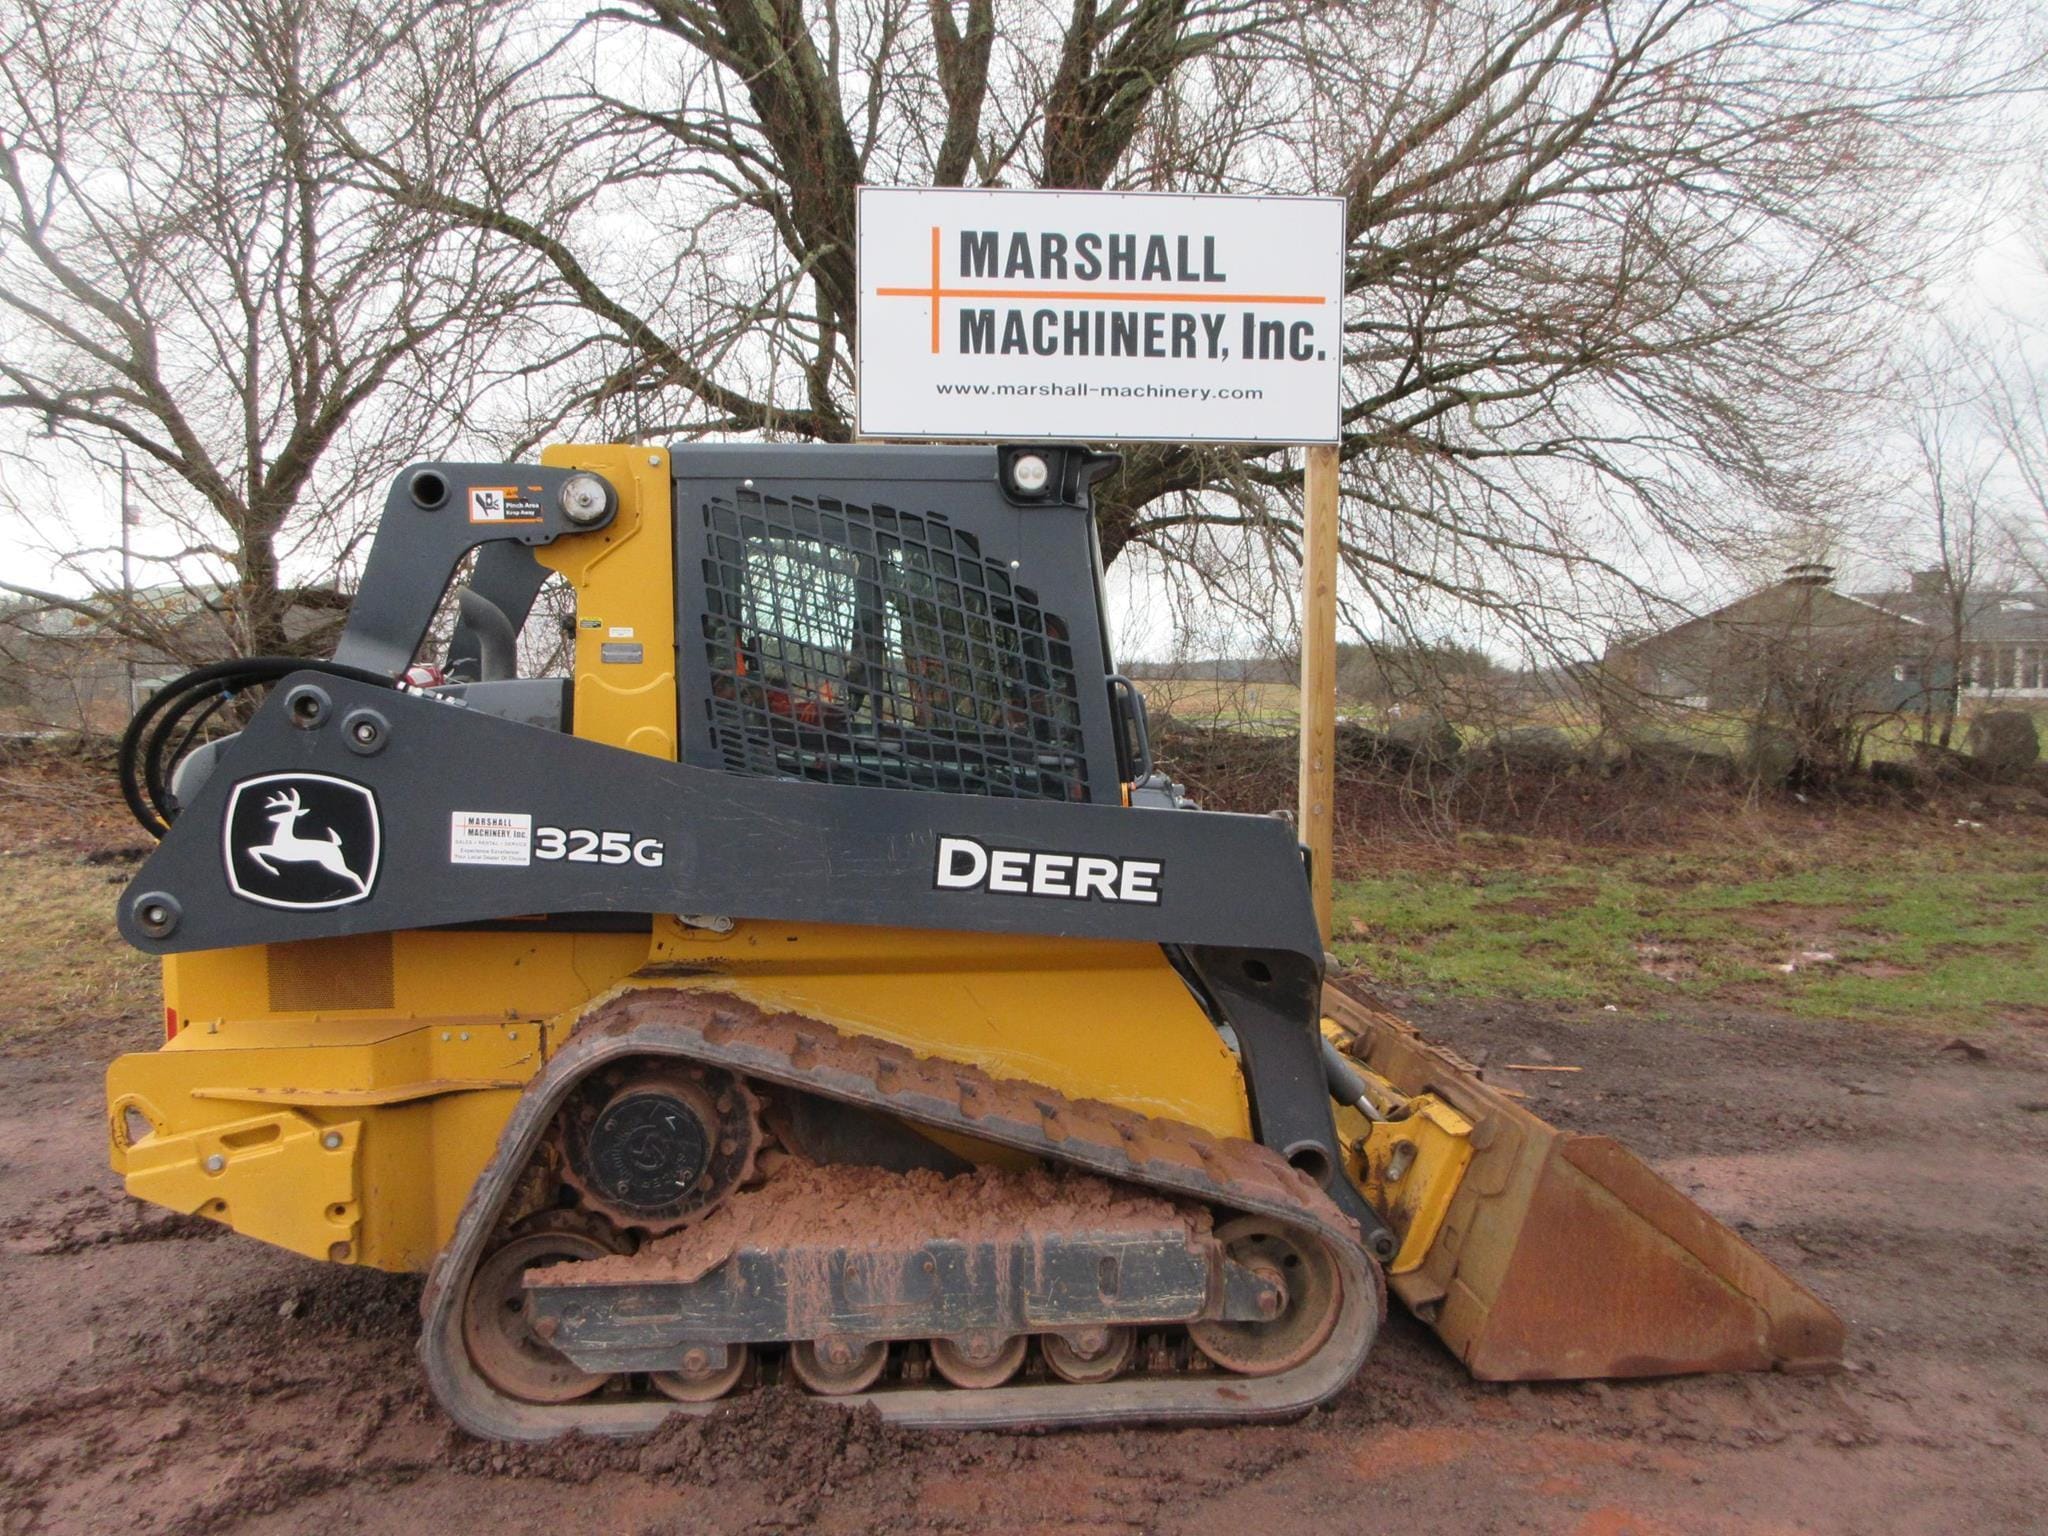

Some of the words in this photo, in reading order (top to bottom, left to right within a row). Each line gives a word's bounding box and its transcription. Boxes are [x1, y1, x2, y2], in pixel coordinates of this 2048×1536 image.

[960, 230, 1226, 283] MARSHALL
[959, 308, 1229, 362] MACHINERY,
[1242, 312, 1327, 361] Inc.
[936, 383, 1264, 401] www.marshall-machinery.com
[468, 817, 512, 827] MARSHALL
[535, 826, 664, 868] 325G
[937, 837, 1161, 902] DEERE
